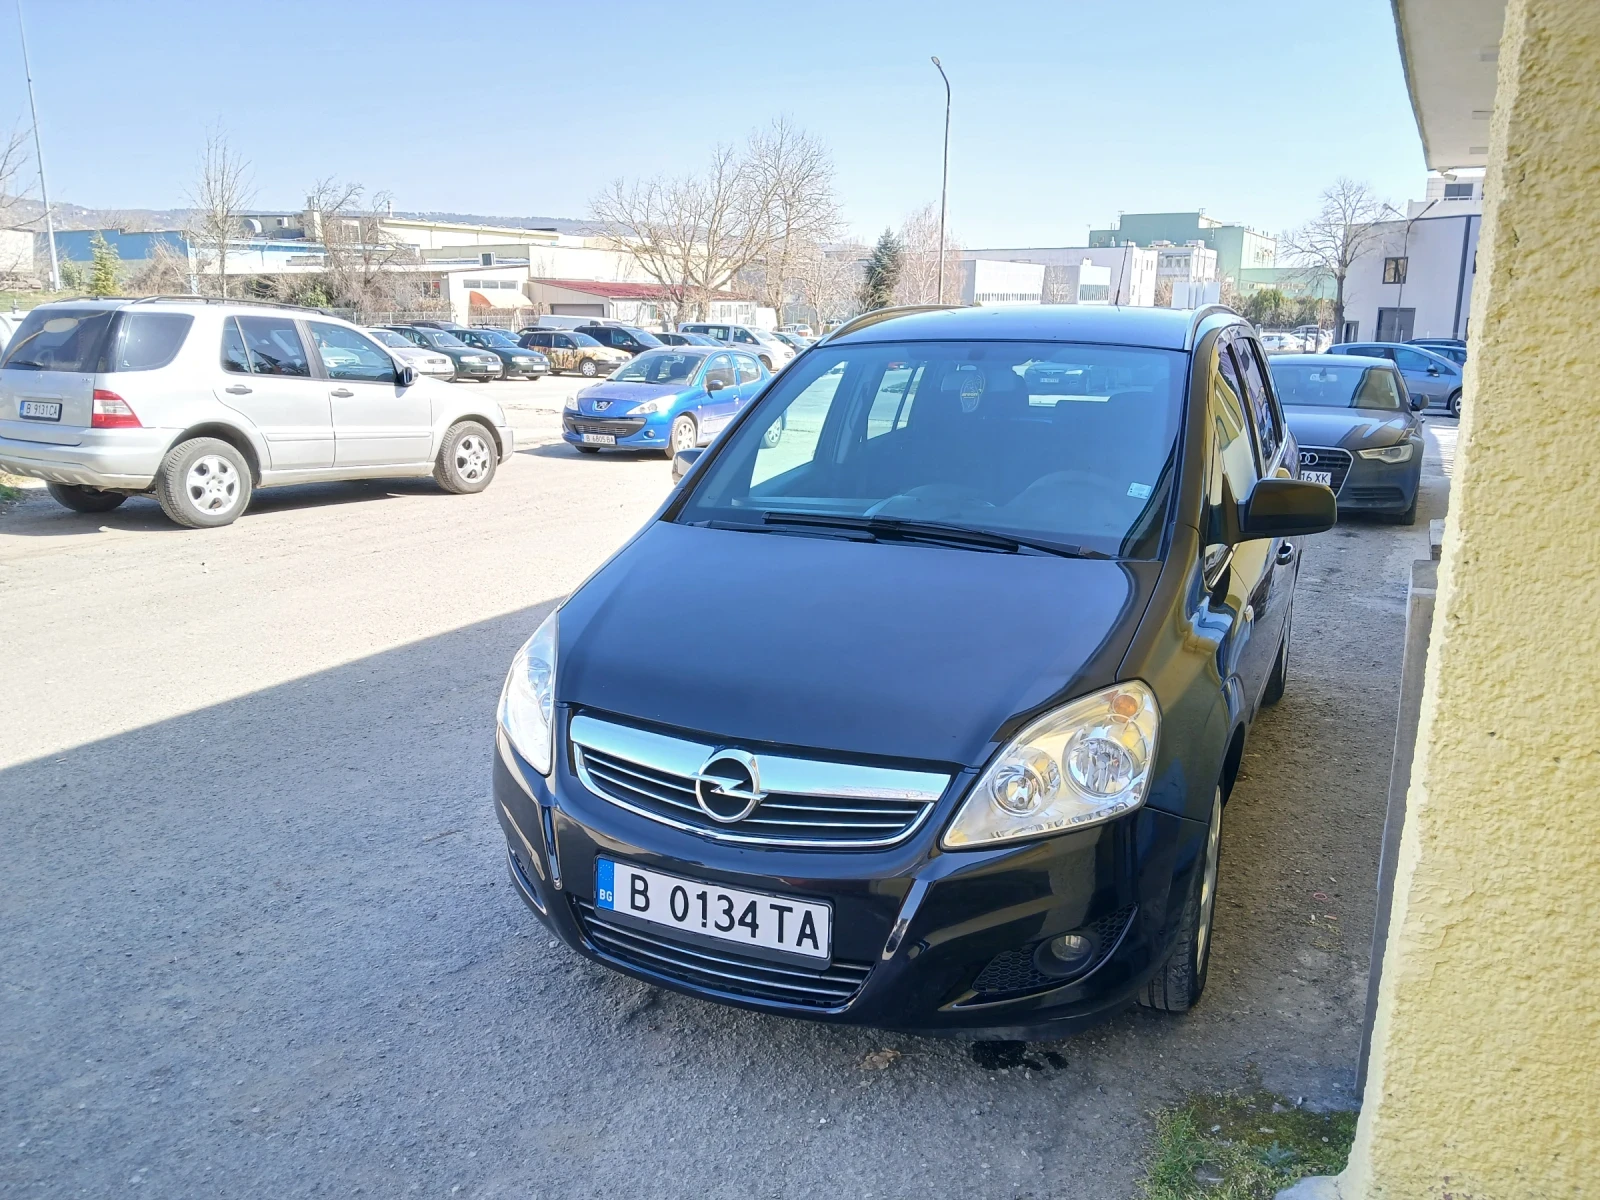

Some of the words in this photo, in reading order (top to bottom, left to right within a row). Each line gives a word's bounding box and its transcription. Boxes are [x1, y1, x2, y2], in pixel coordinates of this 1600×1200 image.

[26, 404, 31, 414] B
[1315, 473, 1328, 483] XK
[599, 888, 613, 902] BG
[630, 873, 650, 912] B
